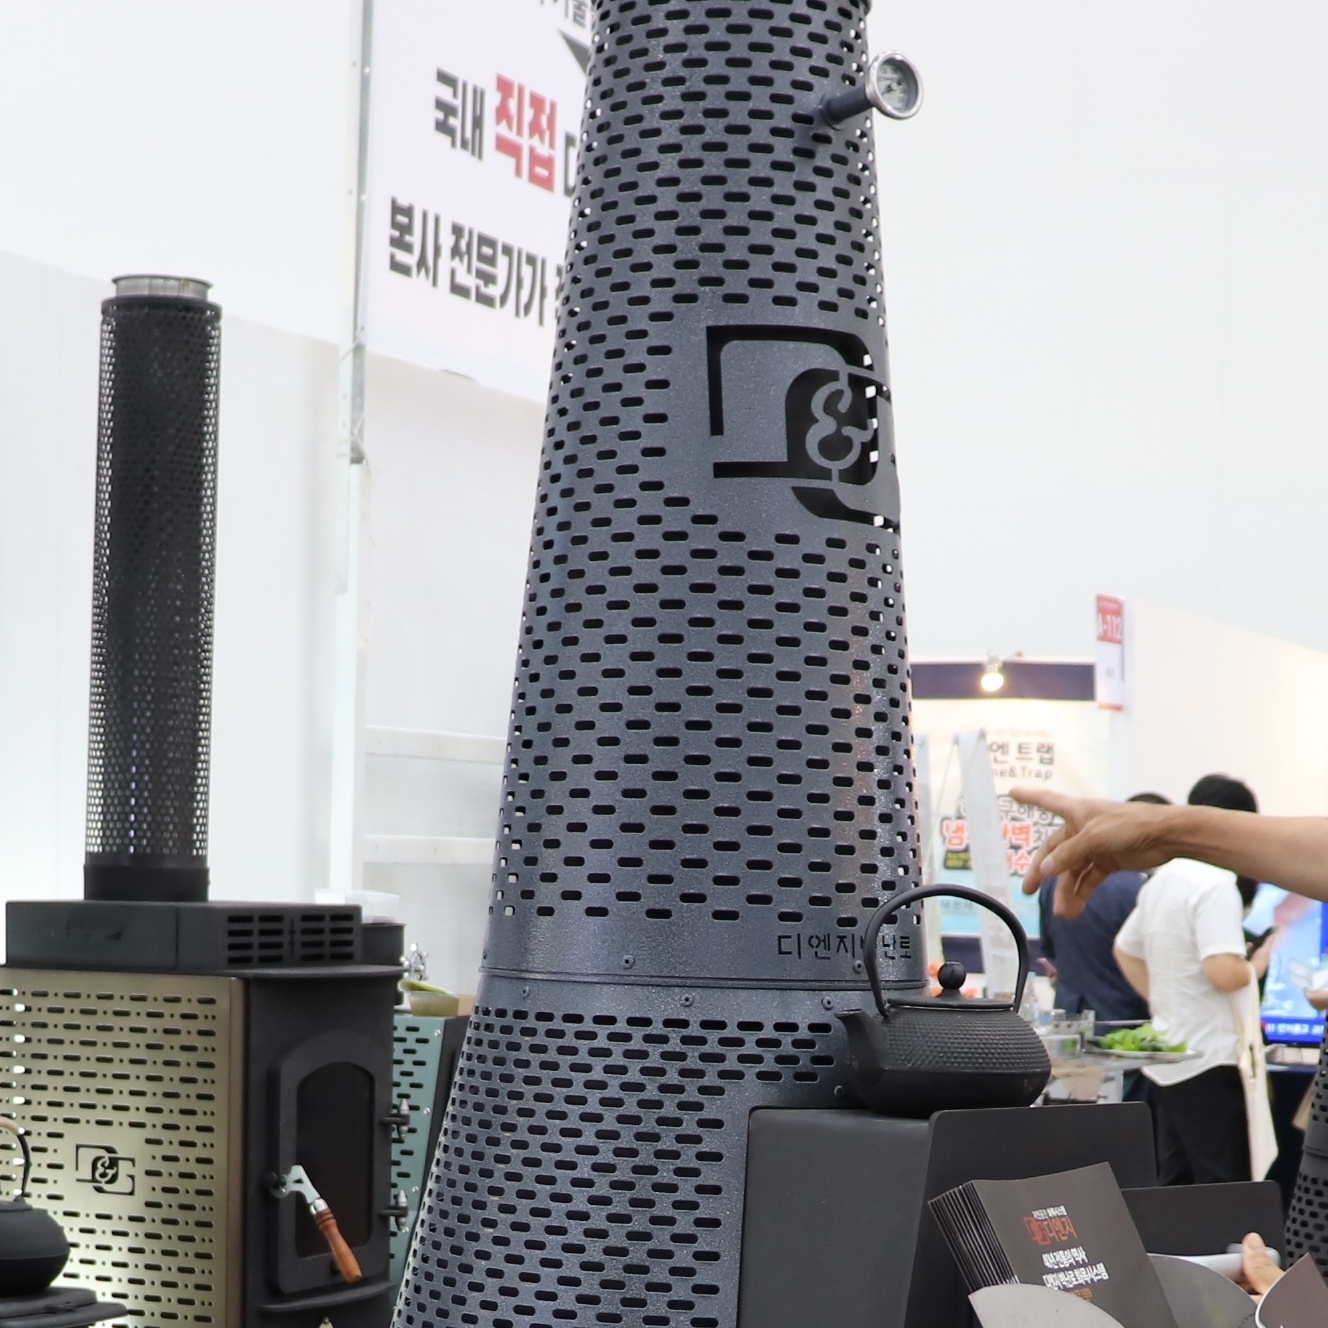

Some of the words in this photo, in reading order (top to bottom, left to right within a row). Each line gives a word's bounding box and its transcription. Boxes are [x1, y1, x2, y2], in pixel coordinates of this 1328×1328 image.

[434, 66, 485, 161] 국내
[495, 72, 557, 193] 직접
[389, 195, 442, 288] 본사
[449, 219, 548, 327] 전문가가
[777, 933, 912, 960] 디엔지난로
